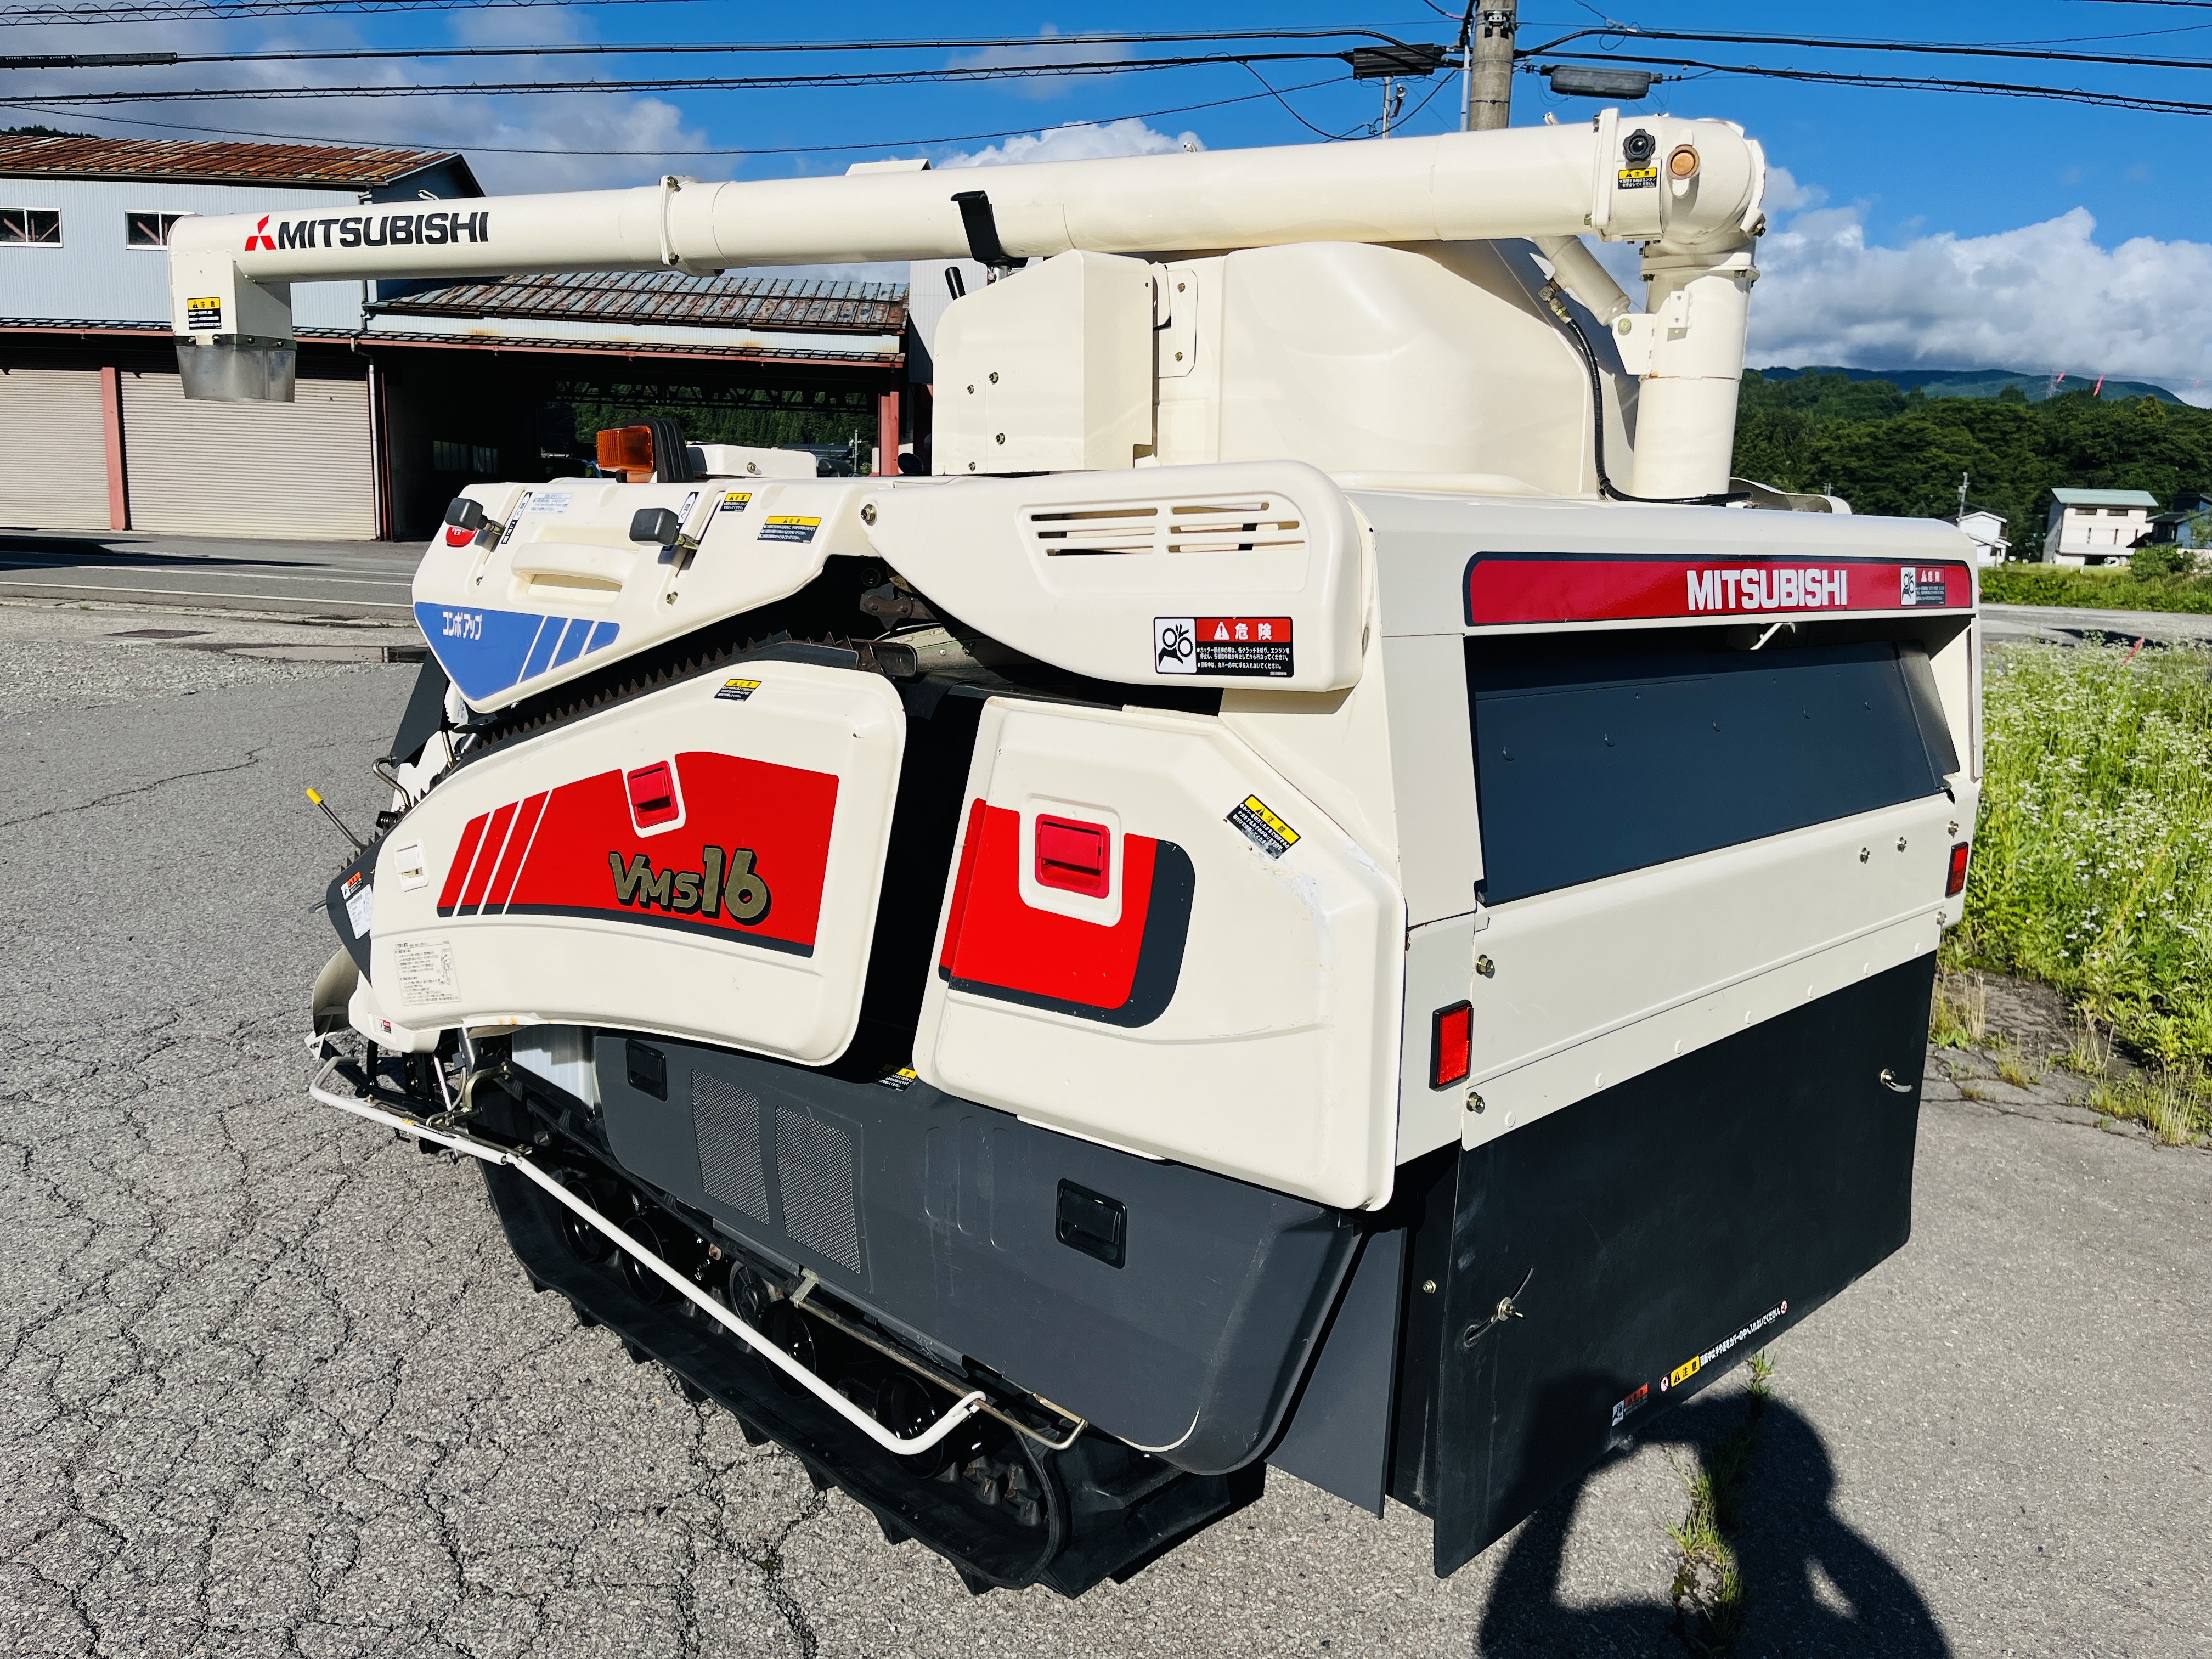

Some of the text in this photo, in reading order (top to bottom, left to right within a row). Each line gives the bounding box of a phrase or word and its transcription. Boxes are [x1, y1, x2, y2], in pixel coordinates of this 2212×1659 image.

[279, 211, 489, 250] MITSUBISHI
[1687, 568, 1847, 610] MITSUBISHI
[1234, 623, 1272, 640] 危険
